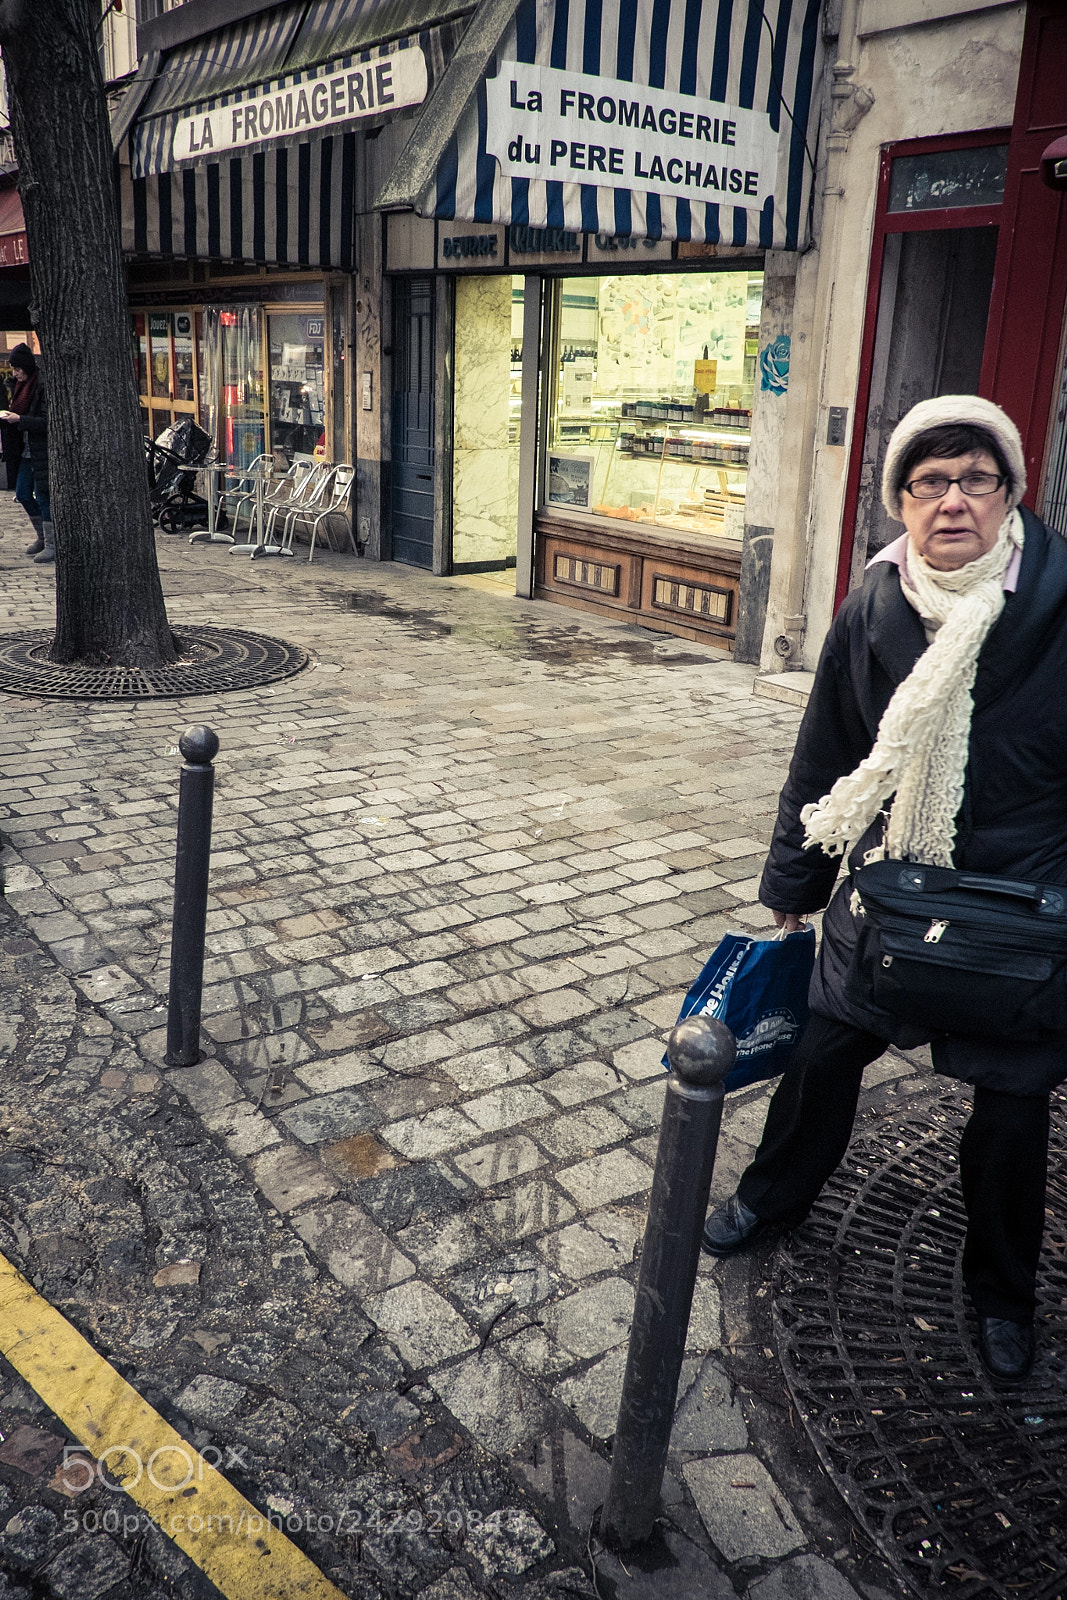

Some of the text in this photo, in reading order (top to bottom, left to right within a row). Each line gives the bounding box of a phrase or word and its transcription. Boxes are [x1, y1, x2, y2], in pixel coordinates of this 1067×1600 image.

[188, 62, 395, 152] LA FROMAGERIE
[509, 80, 737, 146] La FROMAGERIE
[507, 134, 759, 196] du PERE LACHAISE
[13, 239, 24, 260] LE
[443, 234, 498, 257] BEURRE
[709, 950, 744, 1000] House
